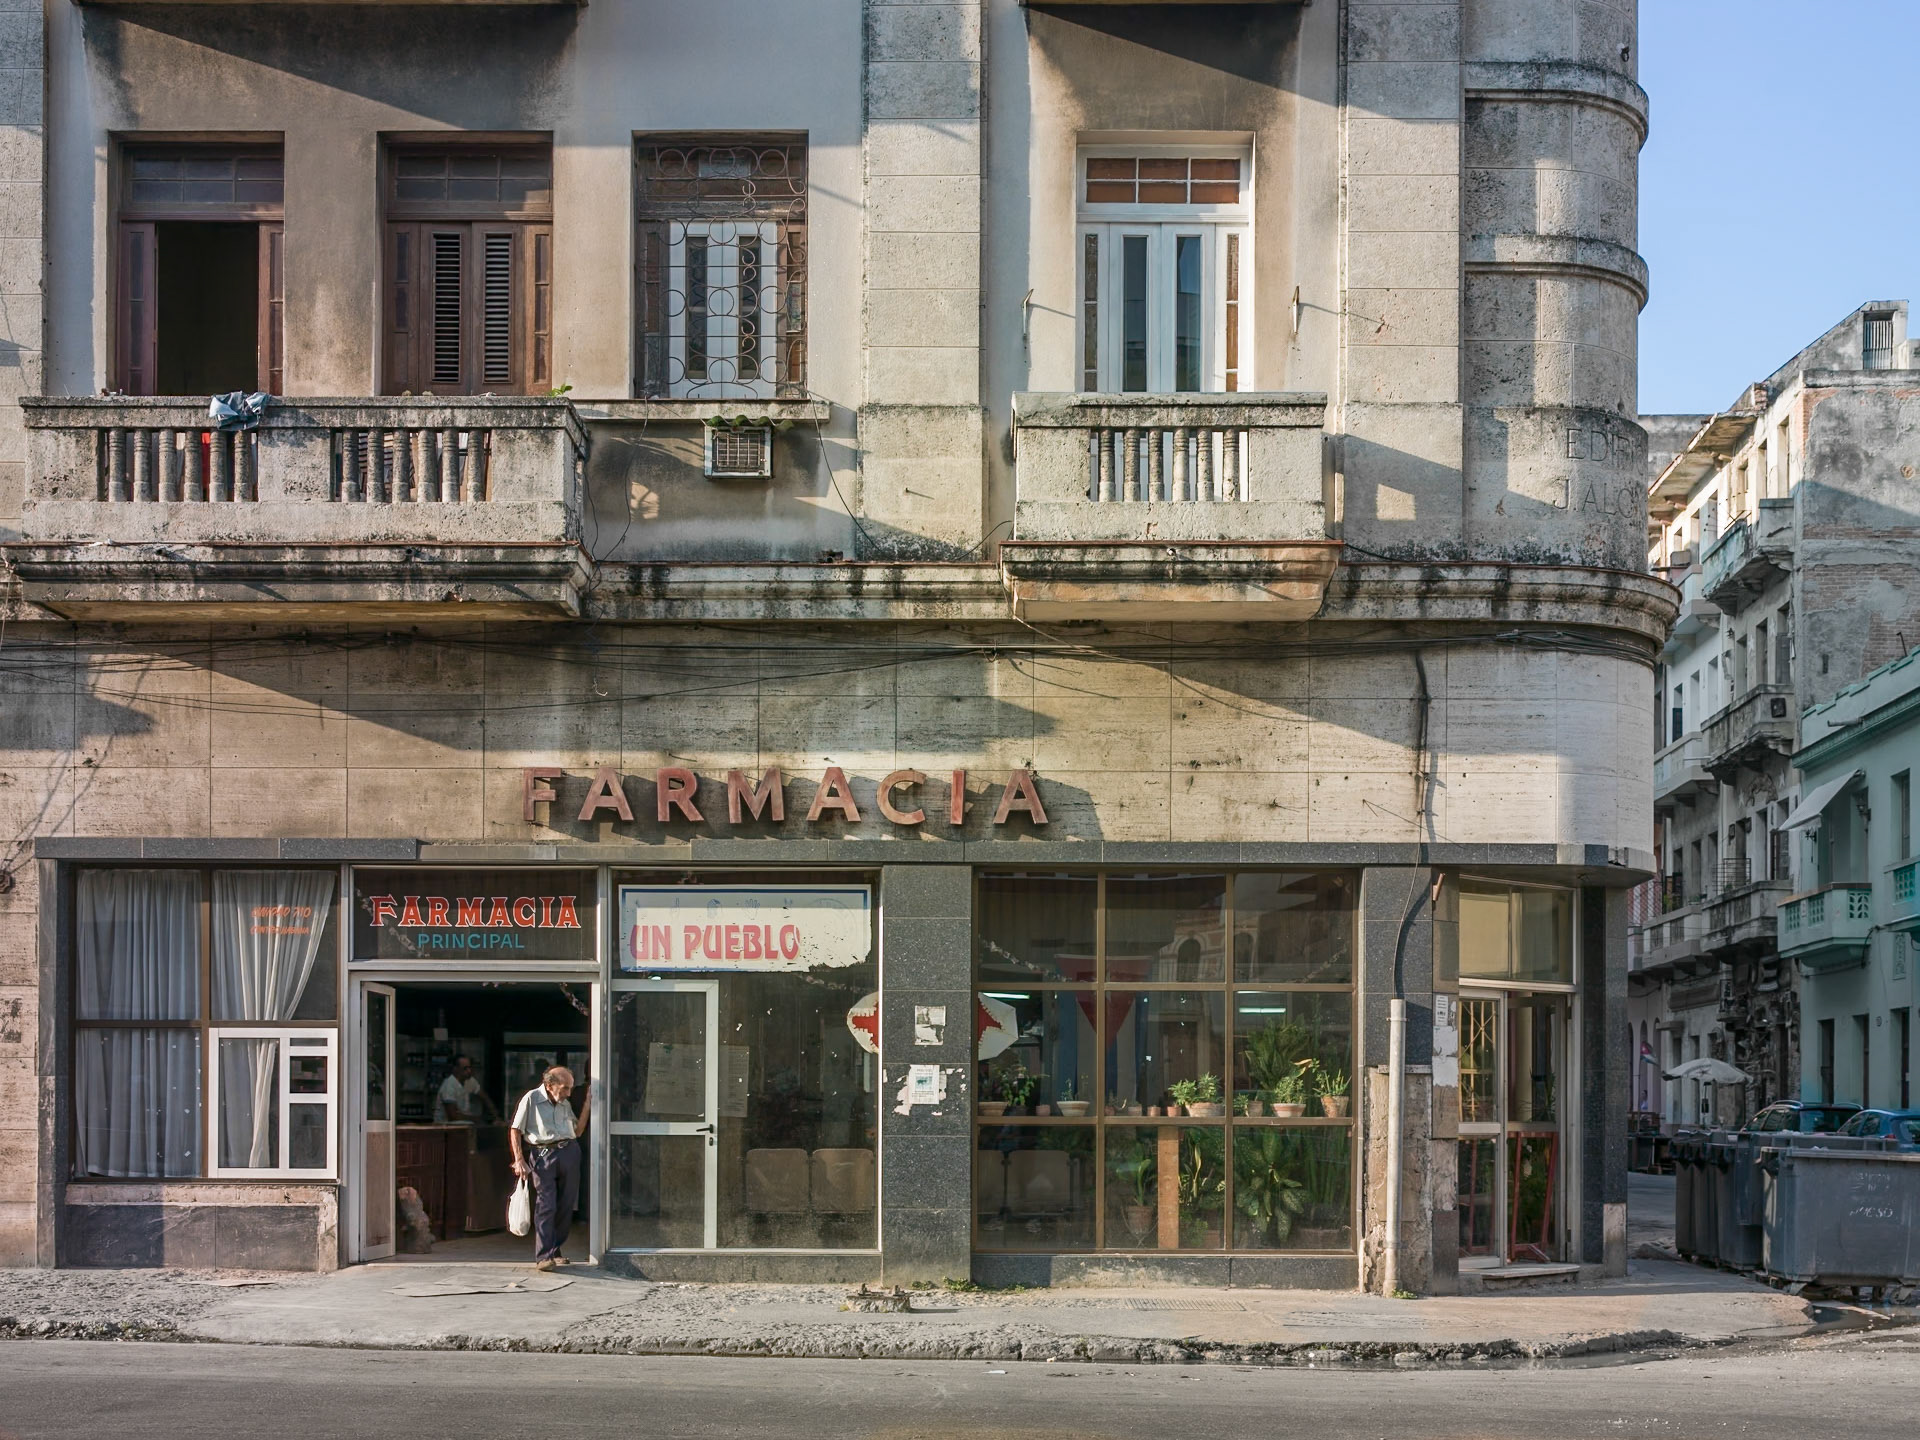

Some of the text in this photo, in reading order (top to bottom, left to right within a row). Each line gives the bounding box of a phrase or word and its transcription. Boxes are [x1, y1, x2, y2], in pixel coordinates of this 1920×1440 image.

[522, 766, 1049, 825] FARMACIA
[369, 893, 582, 929] FARMACIA
[417, 932, 525, 949] PRINCIPAL
[630, 924, 800, 960] UN PUEBLO
